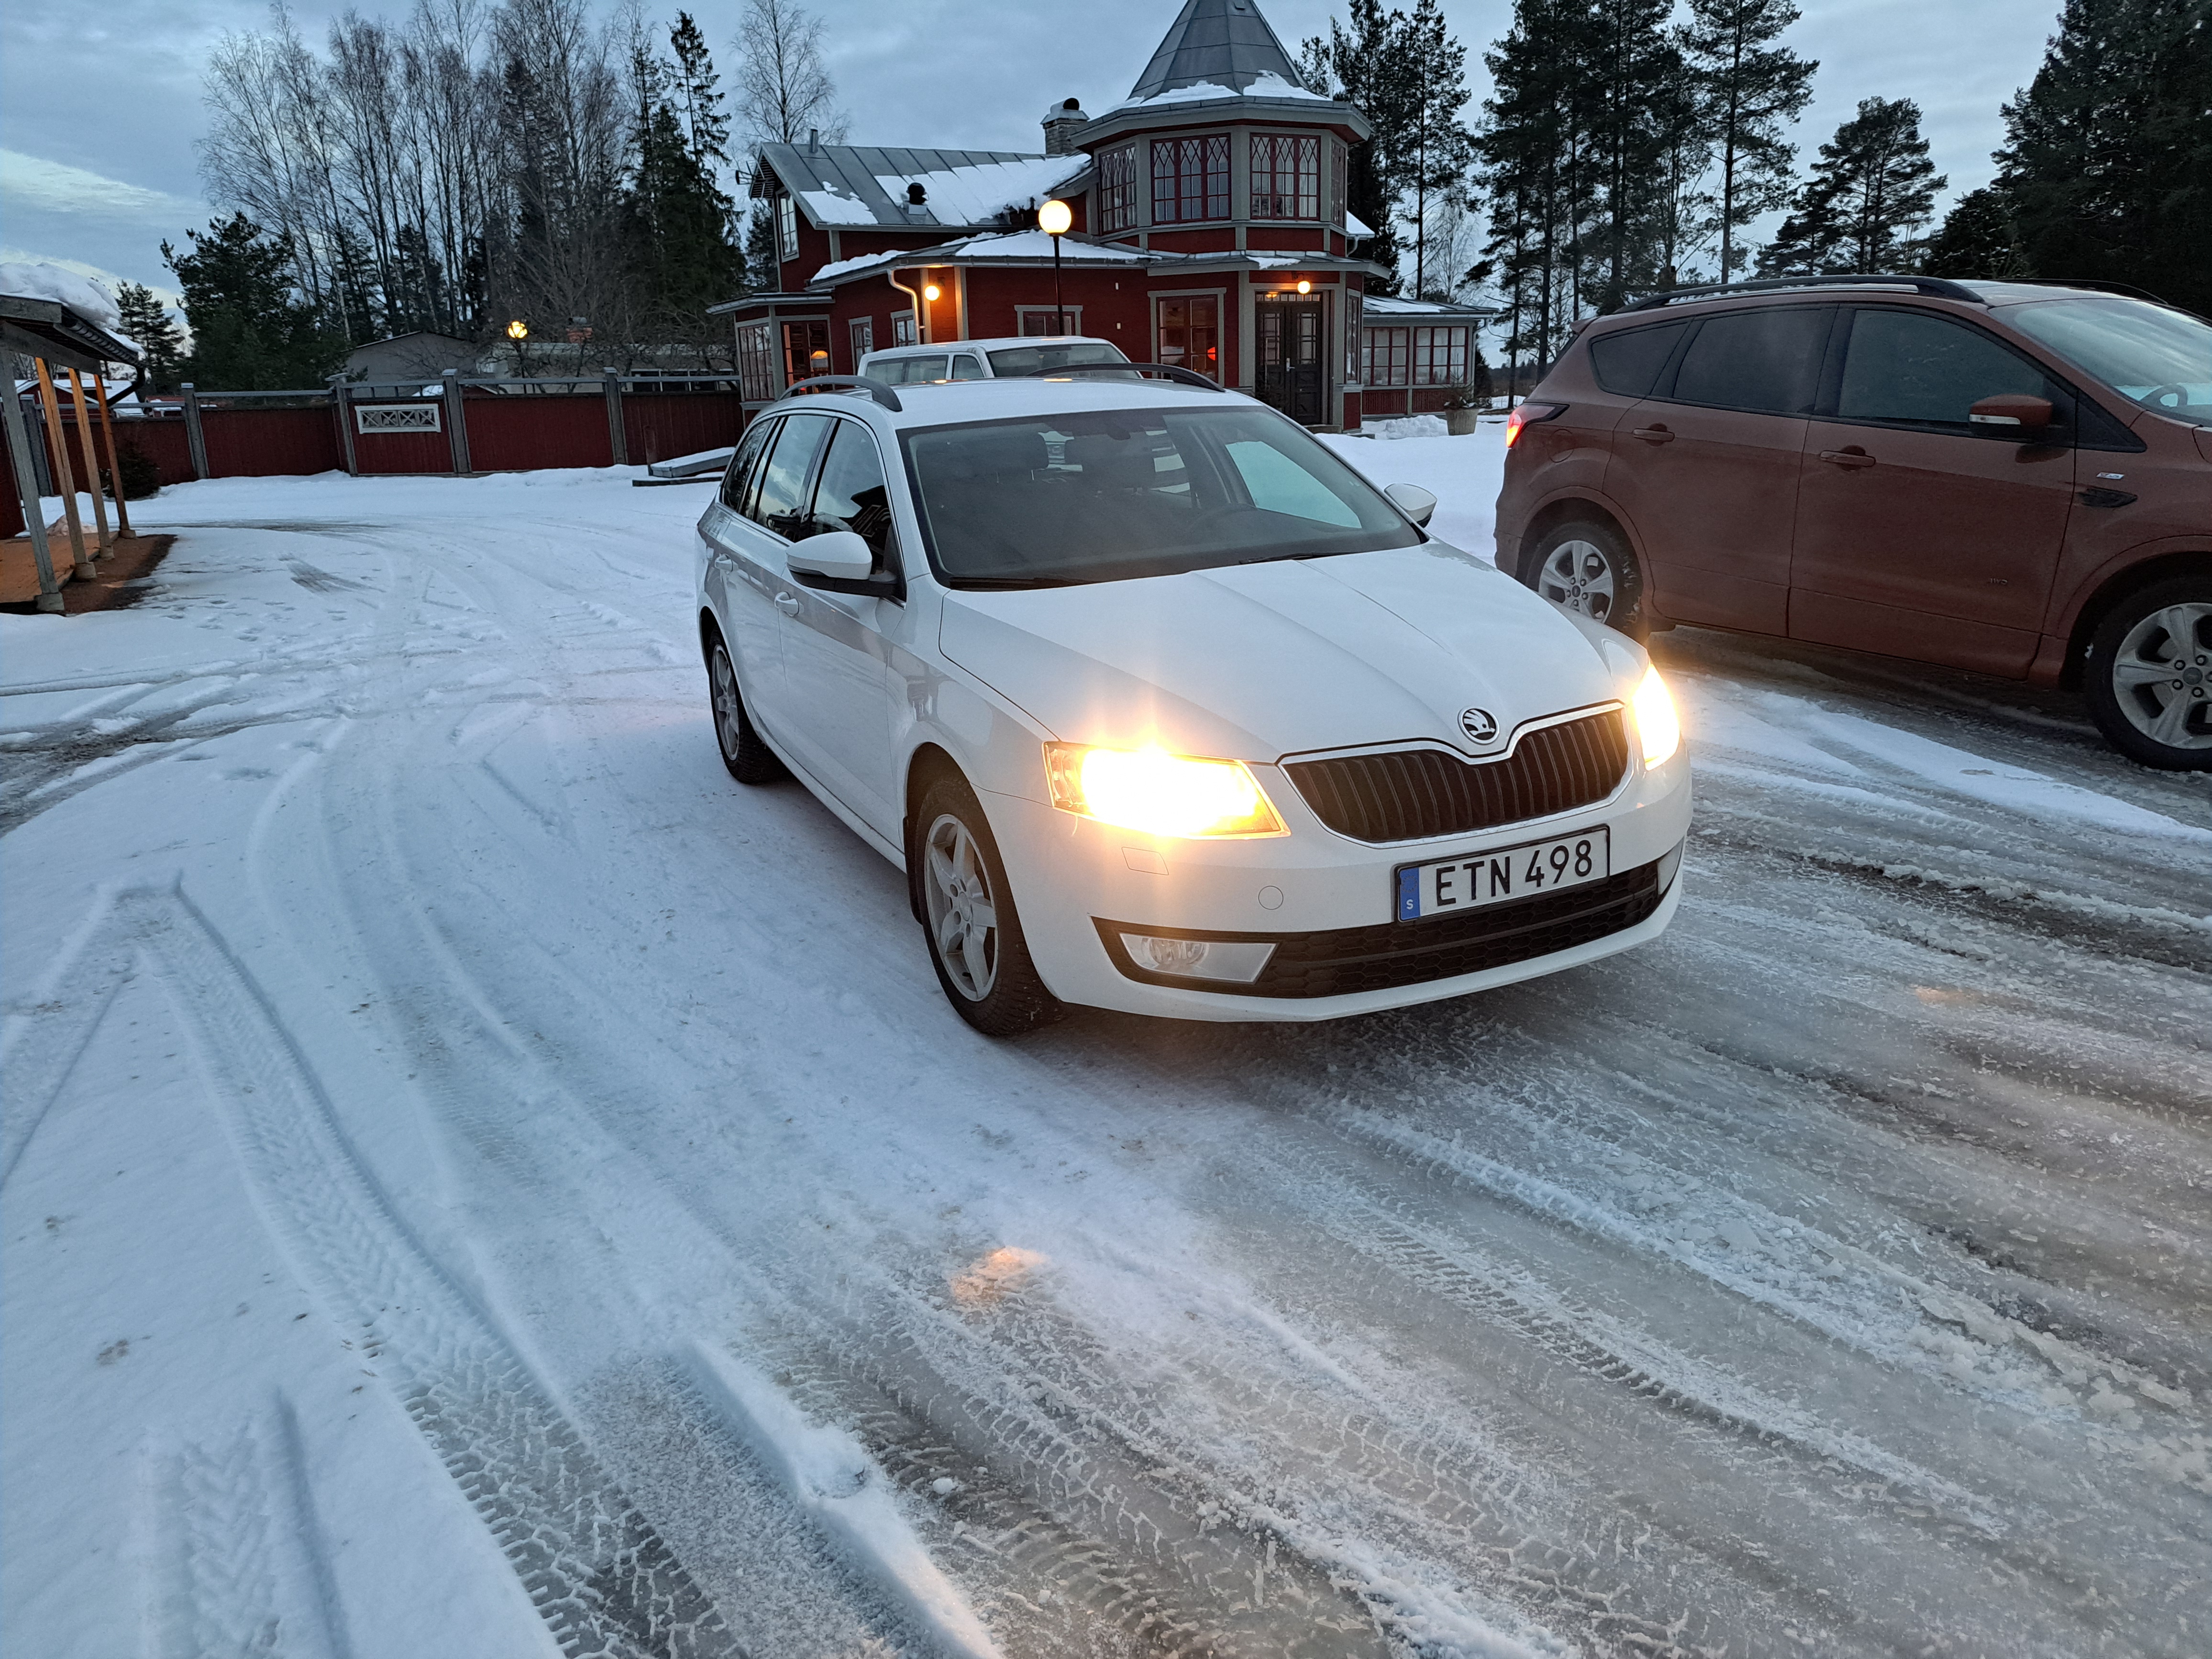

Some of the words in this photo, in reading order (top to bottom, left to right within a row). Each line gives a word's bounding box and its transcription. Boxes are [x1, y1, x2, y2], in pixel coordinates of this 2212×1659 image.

[1436, 856, 1511, 907] ETN
[1525, 840, 1593, 887] 498
[1406, 898, 1414, 910] S
